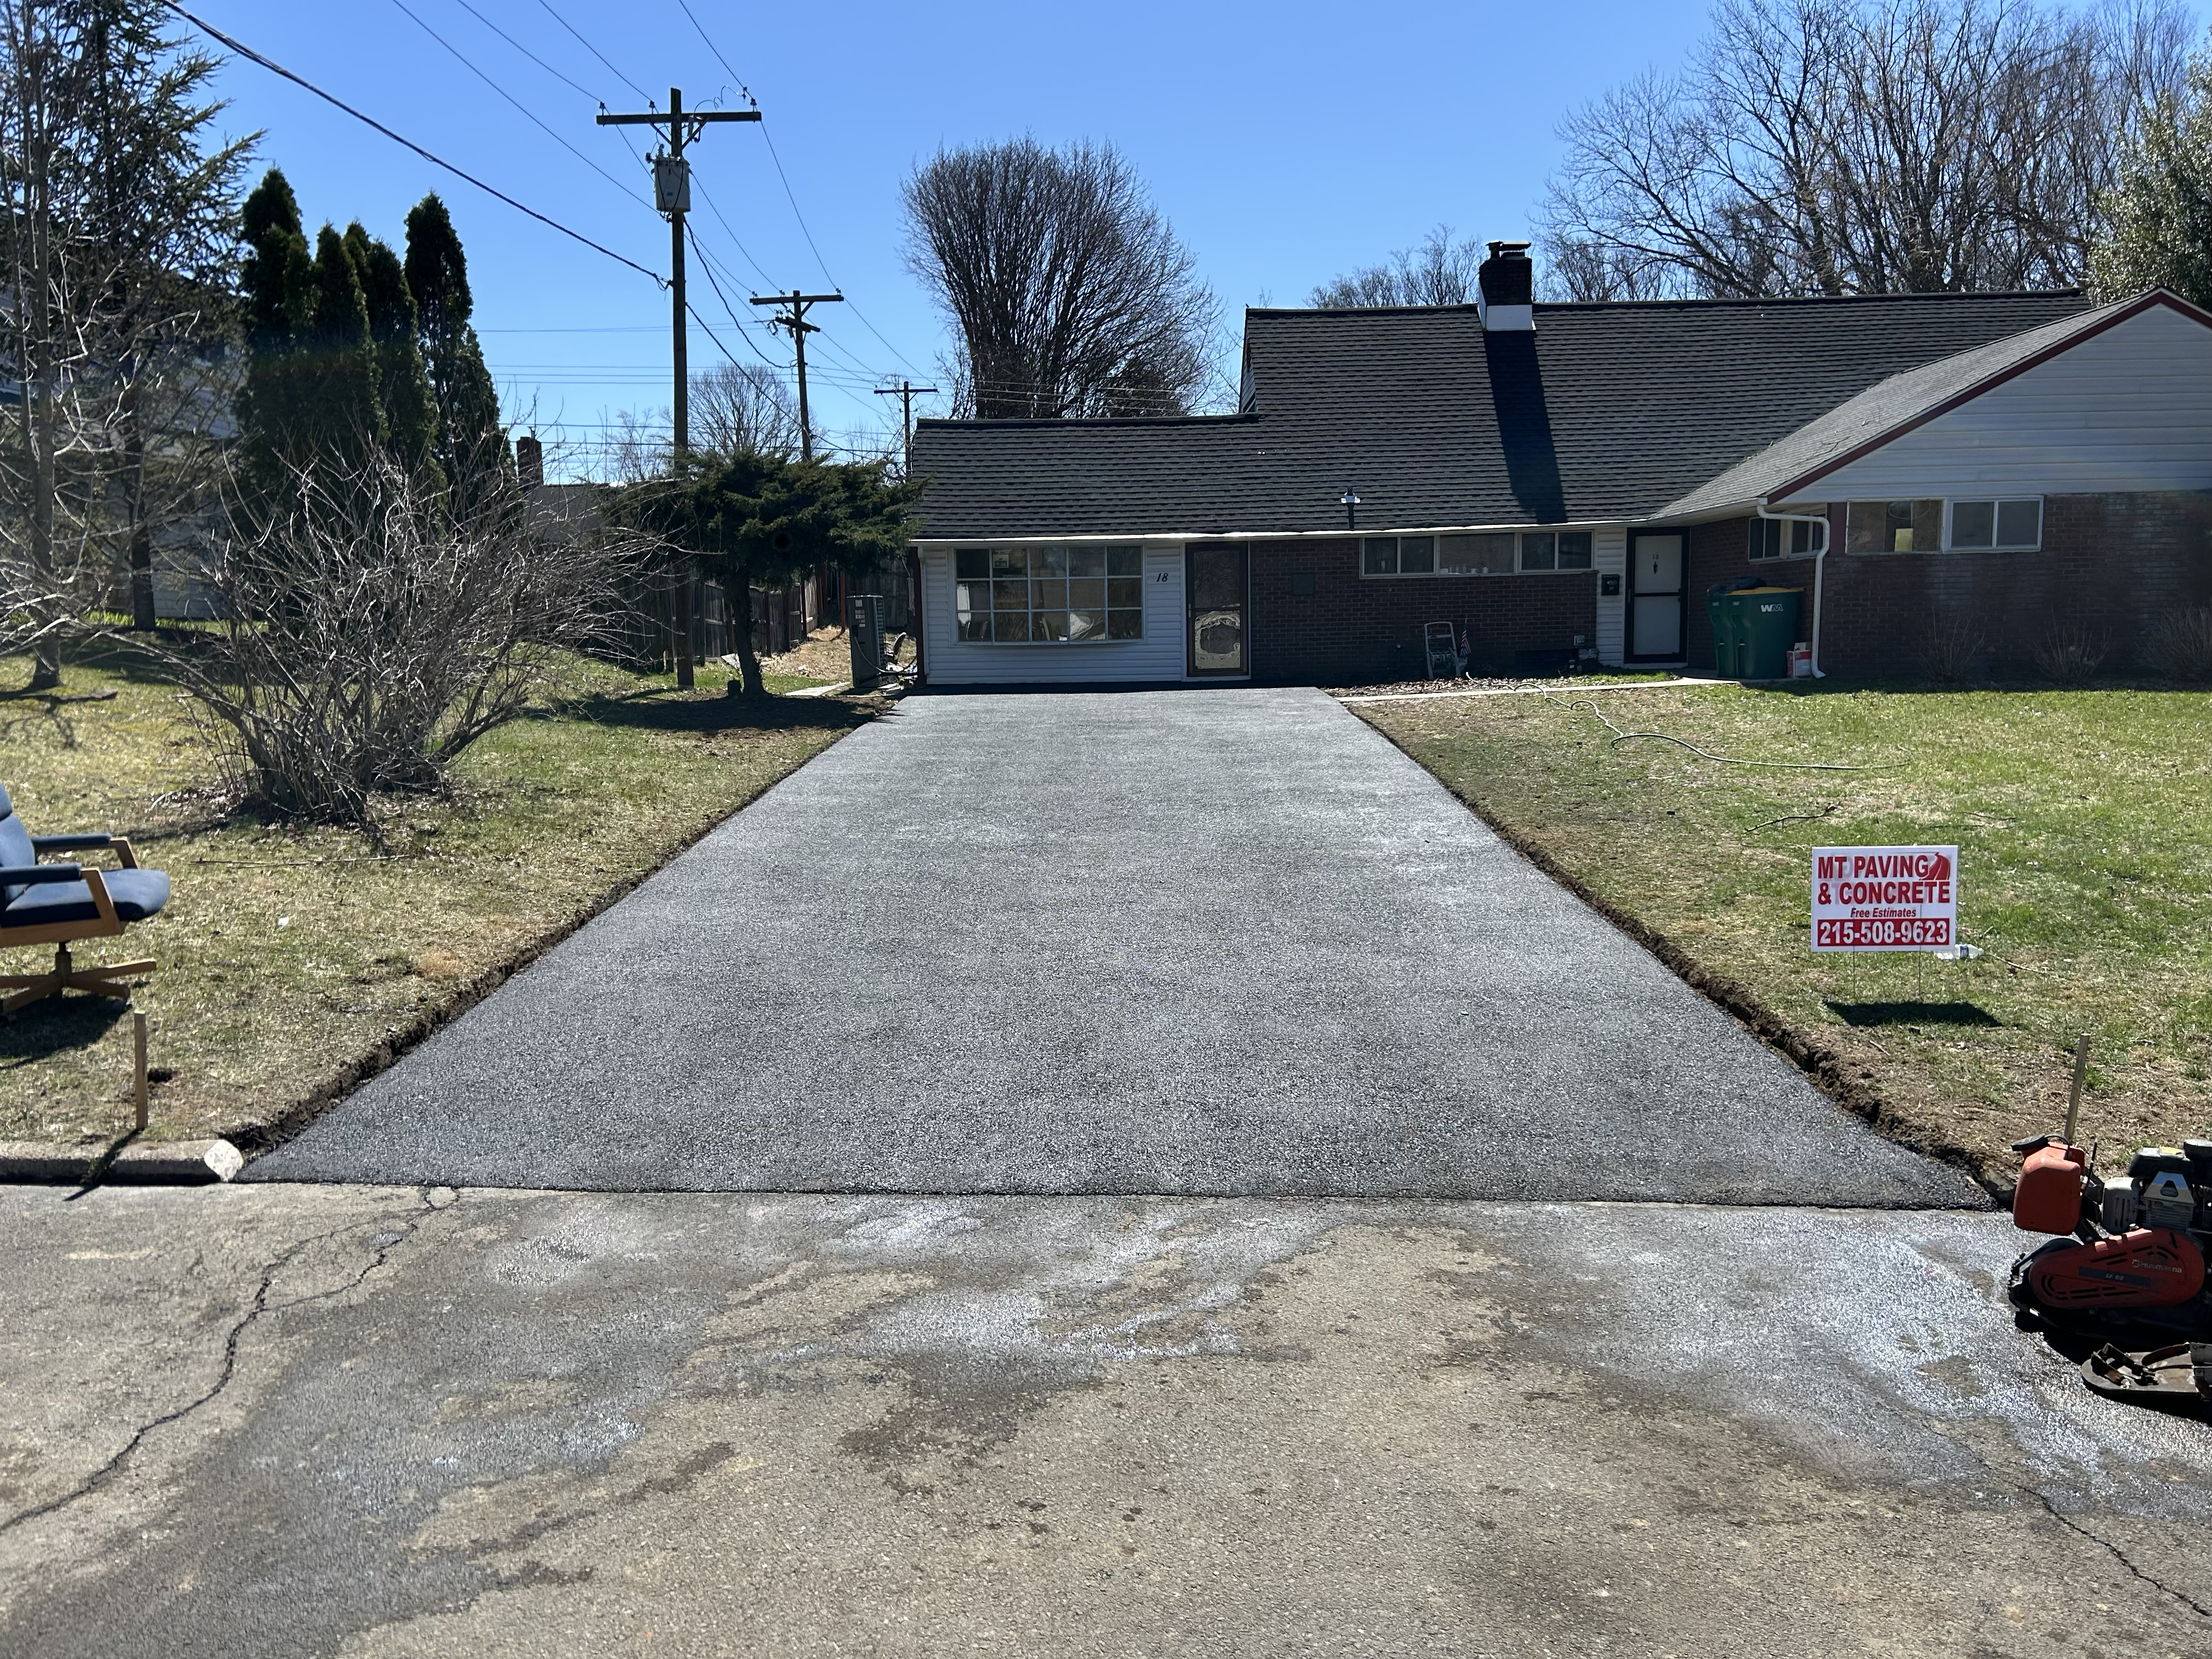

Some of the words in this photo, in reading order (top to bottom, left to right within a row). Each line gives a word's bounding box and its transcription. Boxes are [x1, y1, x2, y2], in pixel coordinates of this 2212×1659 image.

[1156, 573, 1169, 582] 18
[1760, 604, 1783, 612] WM
[1818, 856, 1847, 878] MT
[1854, 855, 1929, 878] PAVING
[1818, 882, 1831, 905] &
[1839, 882, 1950, 904] CONCRETE
[1850, 907, 1870, 918] Free
[1872, 907, 1916, 918] Estimates
[1820, 921, 1947, 944] 215-508-9623
